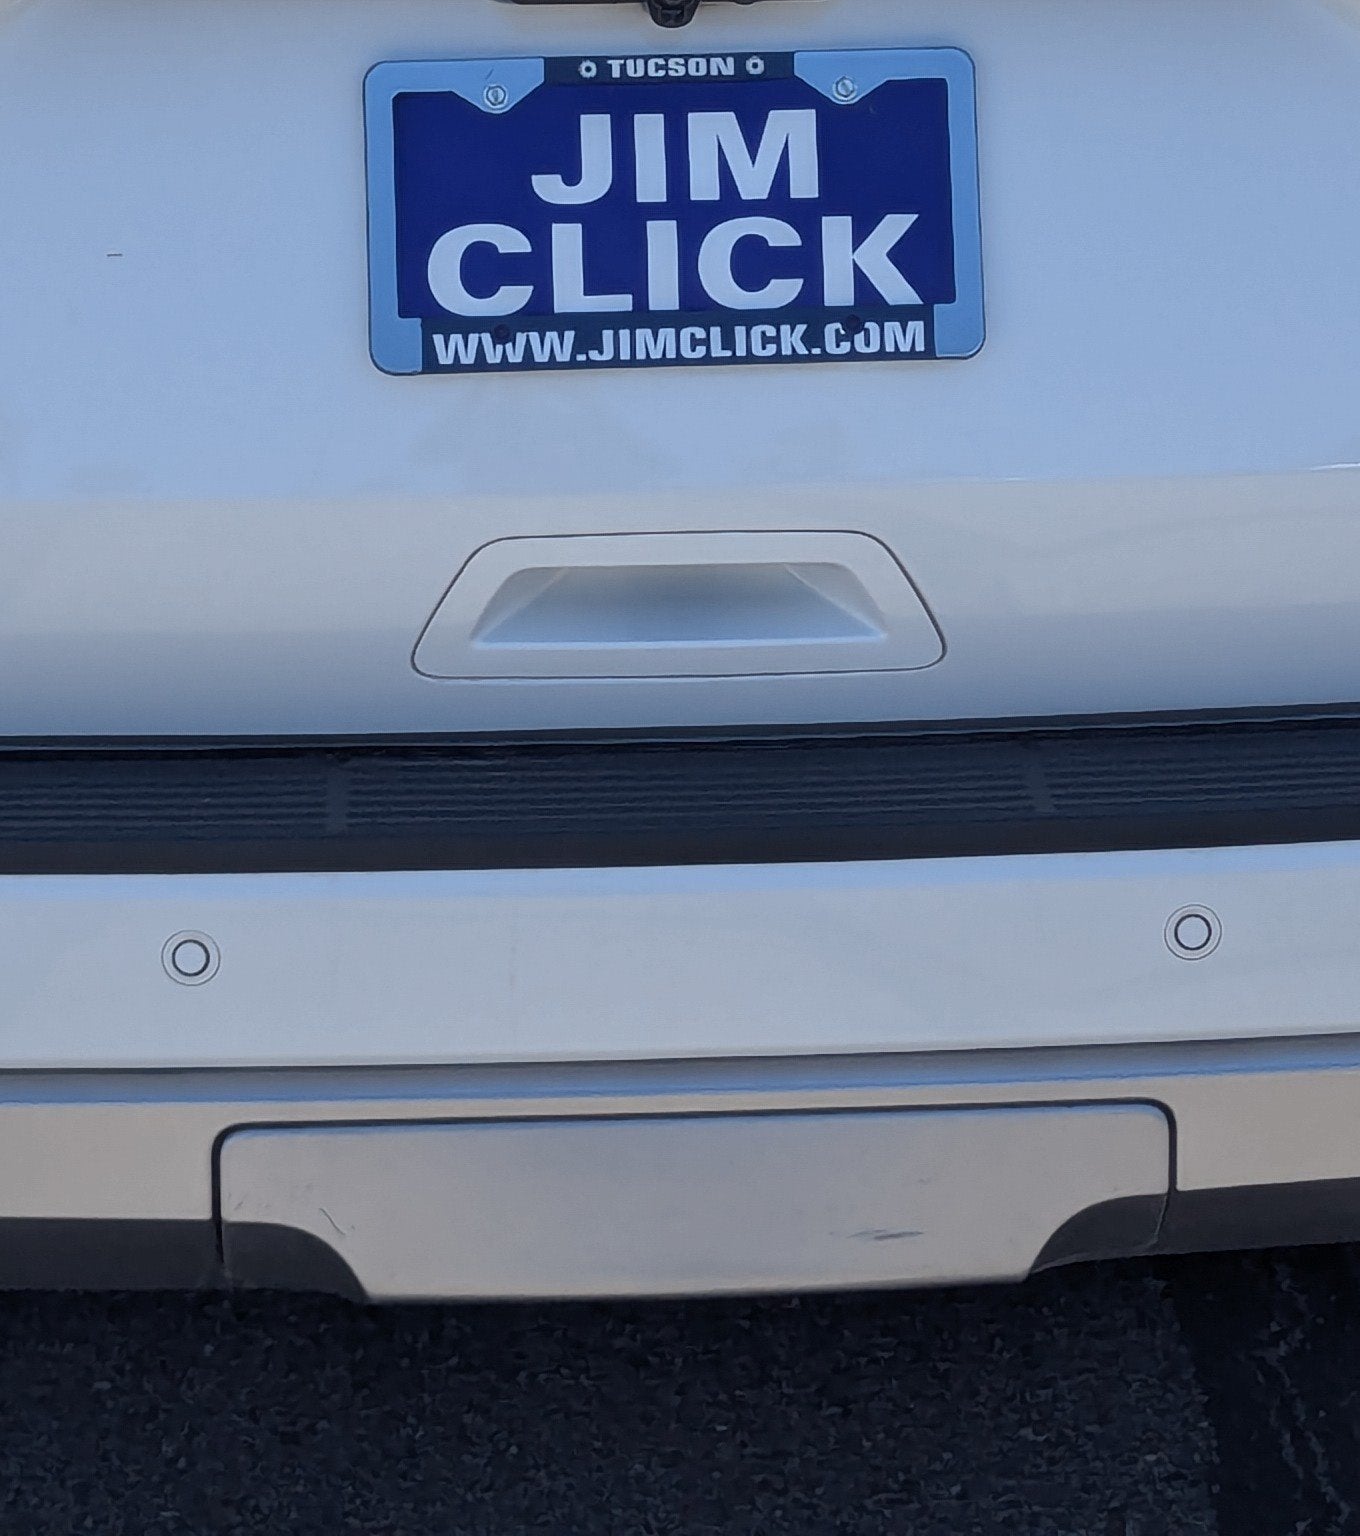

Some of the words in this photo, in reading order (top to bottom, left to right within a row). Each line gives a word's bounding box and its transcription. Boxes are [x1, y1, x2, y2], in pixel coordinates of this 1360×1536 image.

[607, 56, 735, 78] TUCSON
[530, 109, 819, 204] JIM
[427, 214, 924, 317] CLICK
[431, 320, 925, 364] WWW.JIMCLICK.COM
